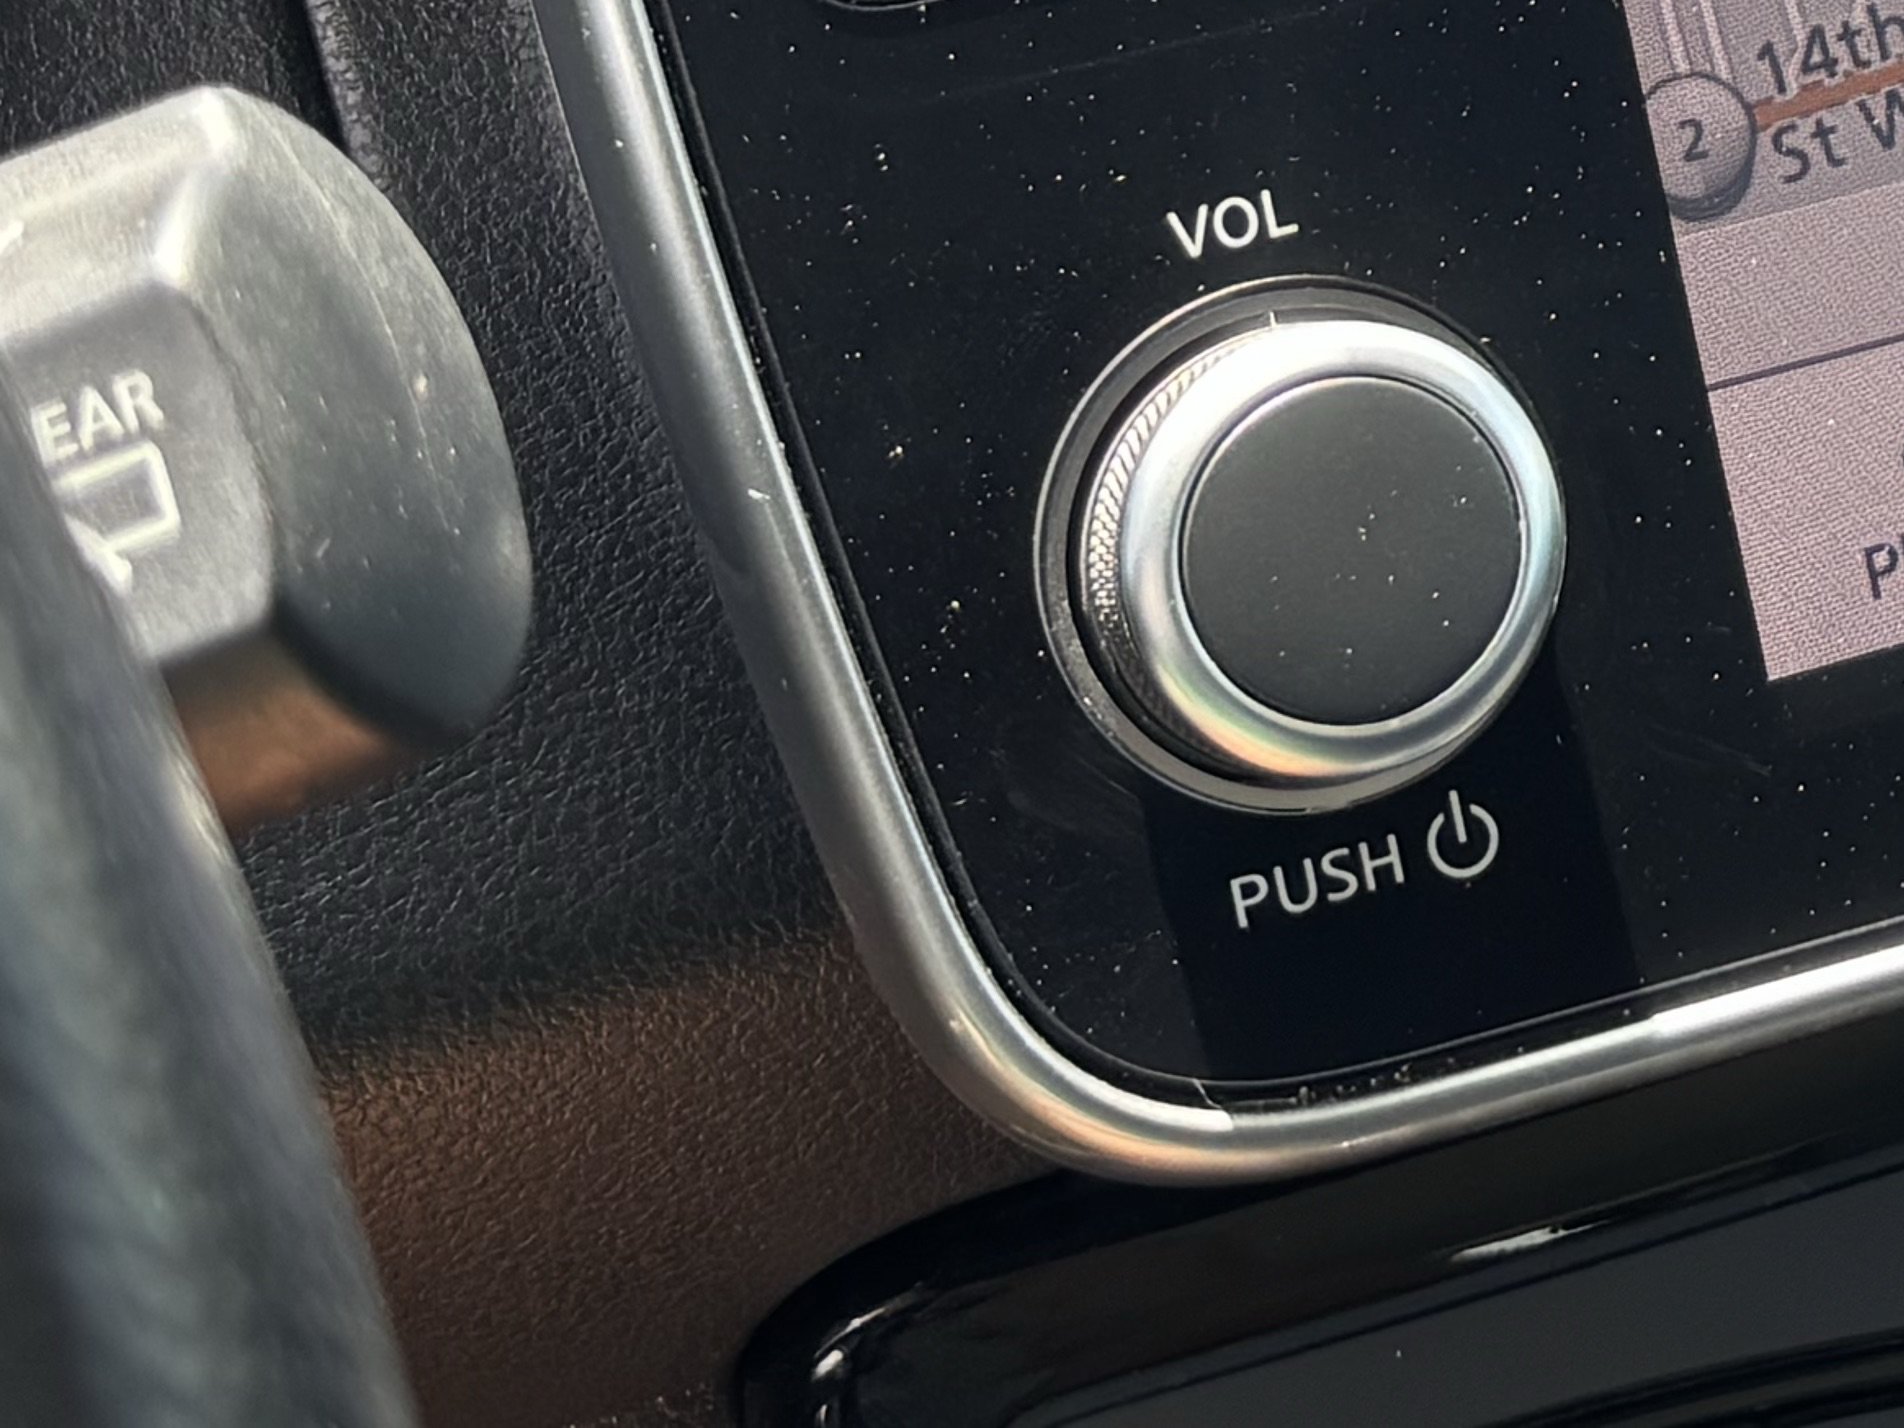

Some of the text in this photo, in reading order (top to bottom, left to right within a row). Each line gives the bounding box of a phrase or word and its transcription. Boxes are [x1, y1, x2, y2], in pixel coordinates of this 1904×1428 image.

[1679, 120, 1705, 163] 2
[1770, 117, 1846, 185] St
[1167, 189, 1299, 260] VOL
[30, 367, 165, 466] EAR
[1229, 834, 1406, 930] PUSH
